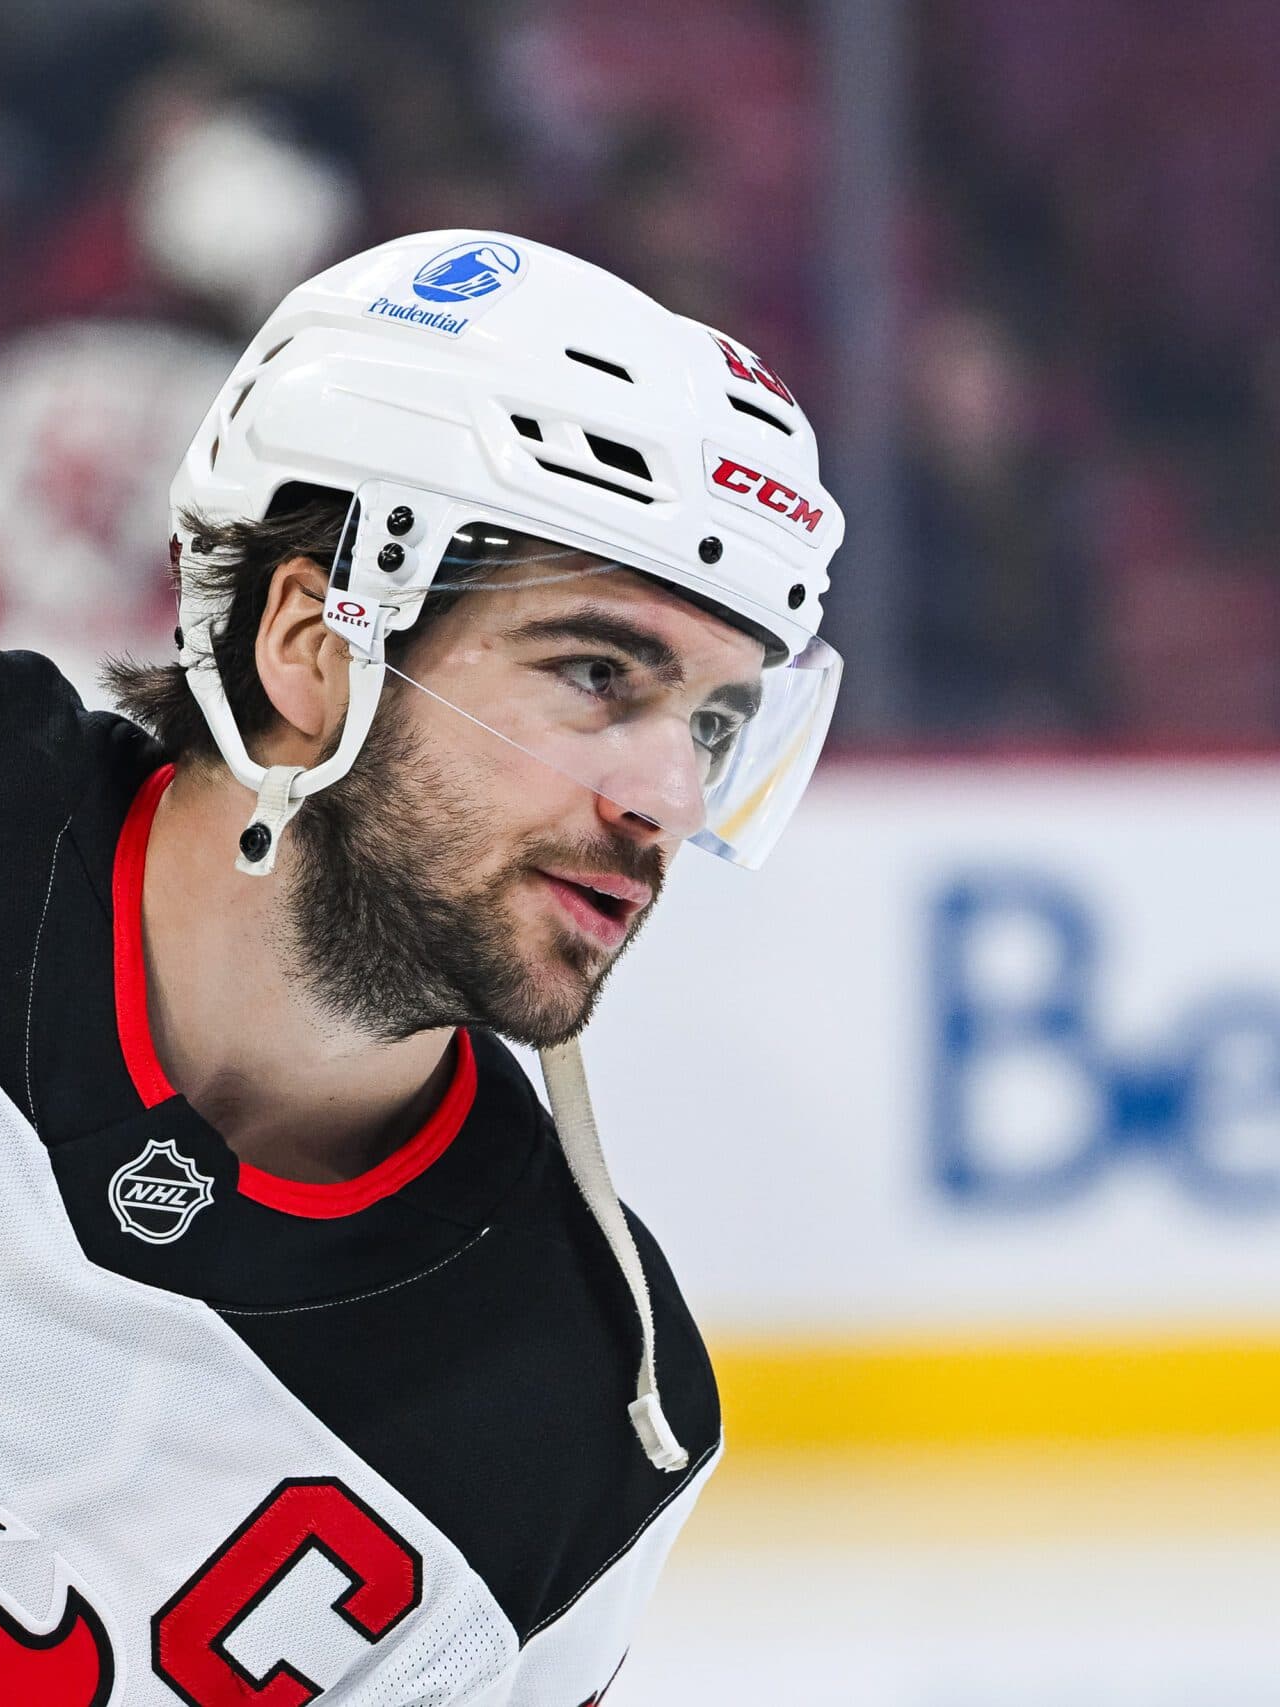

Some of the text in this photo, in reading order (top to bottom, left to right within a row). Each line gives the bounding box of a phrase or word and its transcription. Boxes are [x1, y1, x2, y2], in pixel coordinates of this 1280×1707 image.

[368, 297, 469, 334] Prudential
[711, 456, 824, 533] CCM
[327, 611, 371, 628] OAKLEY
[123, 1182, 188, 1206] NHL
[150, 1476, 423, 1707] C
